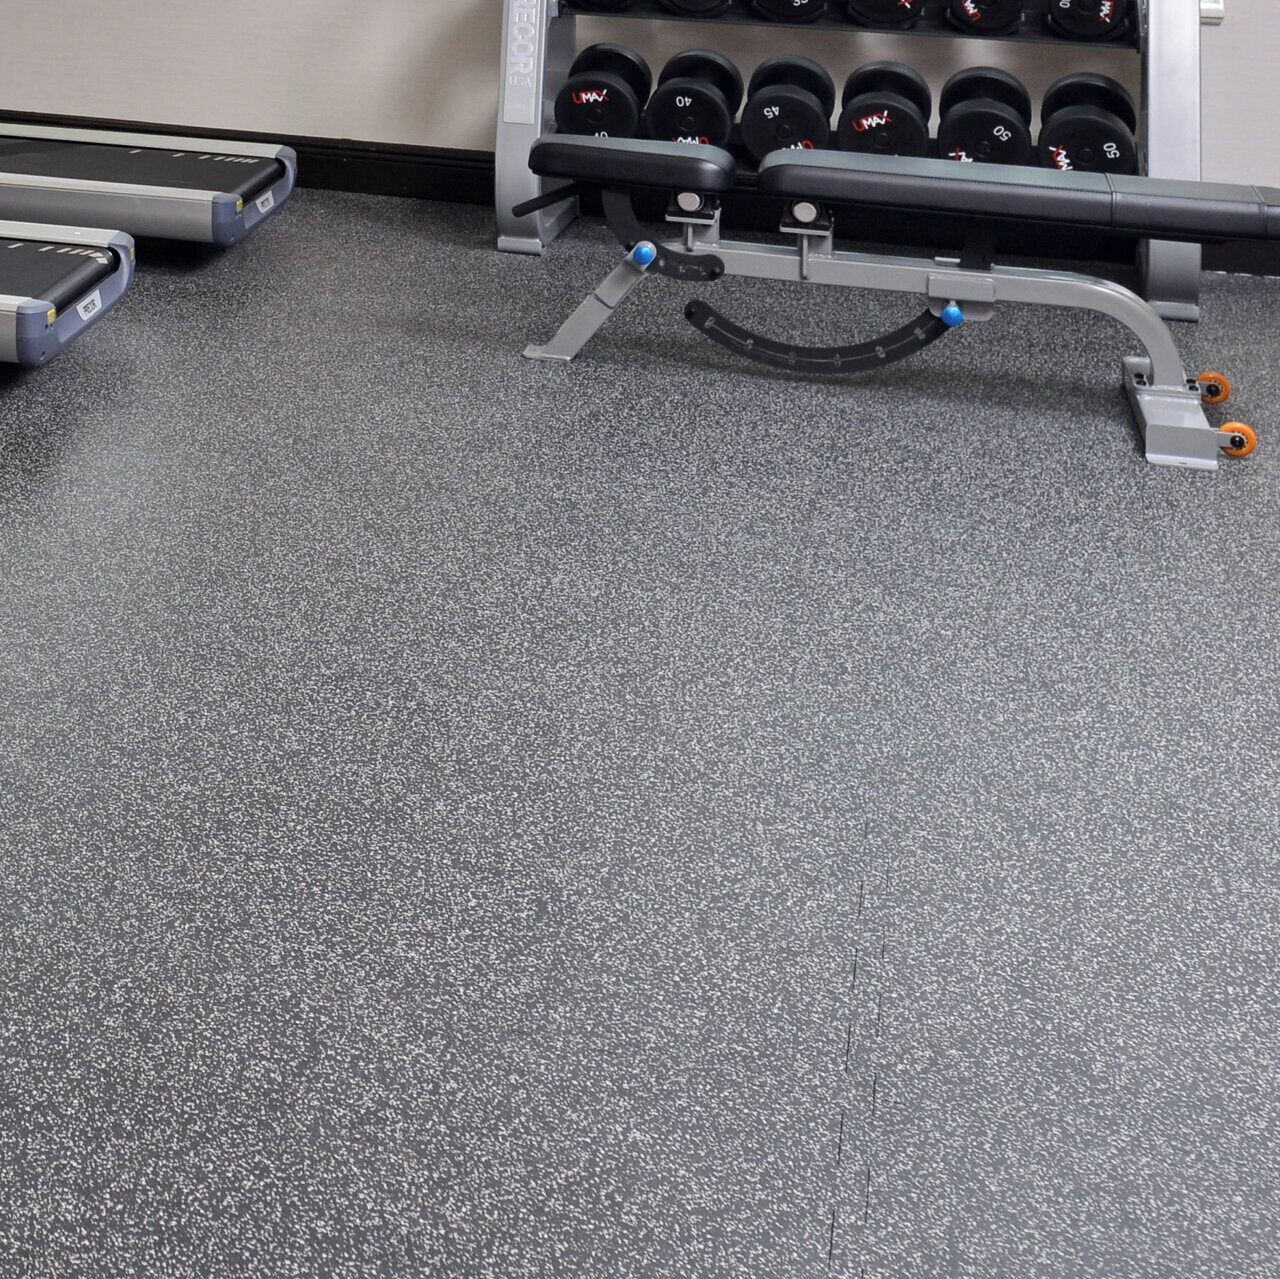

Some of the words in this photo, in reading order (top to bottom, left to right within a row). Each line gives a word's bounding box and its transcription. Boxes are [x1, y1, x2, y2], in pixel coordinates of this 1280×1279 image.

[509, 75, 532, 88] USA
[571, 89, 609, 104] UMAX
[676, 96, 692, 107] 40
[764, 105, 780, 119] 45
[852, 110, 893, 132] UMAX
[993, 125, 1011, 142] 50
[1103, 142, 1120, 159] 50
